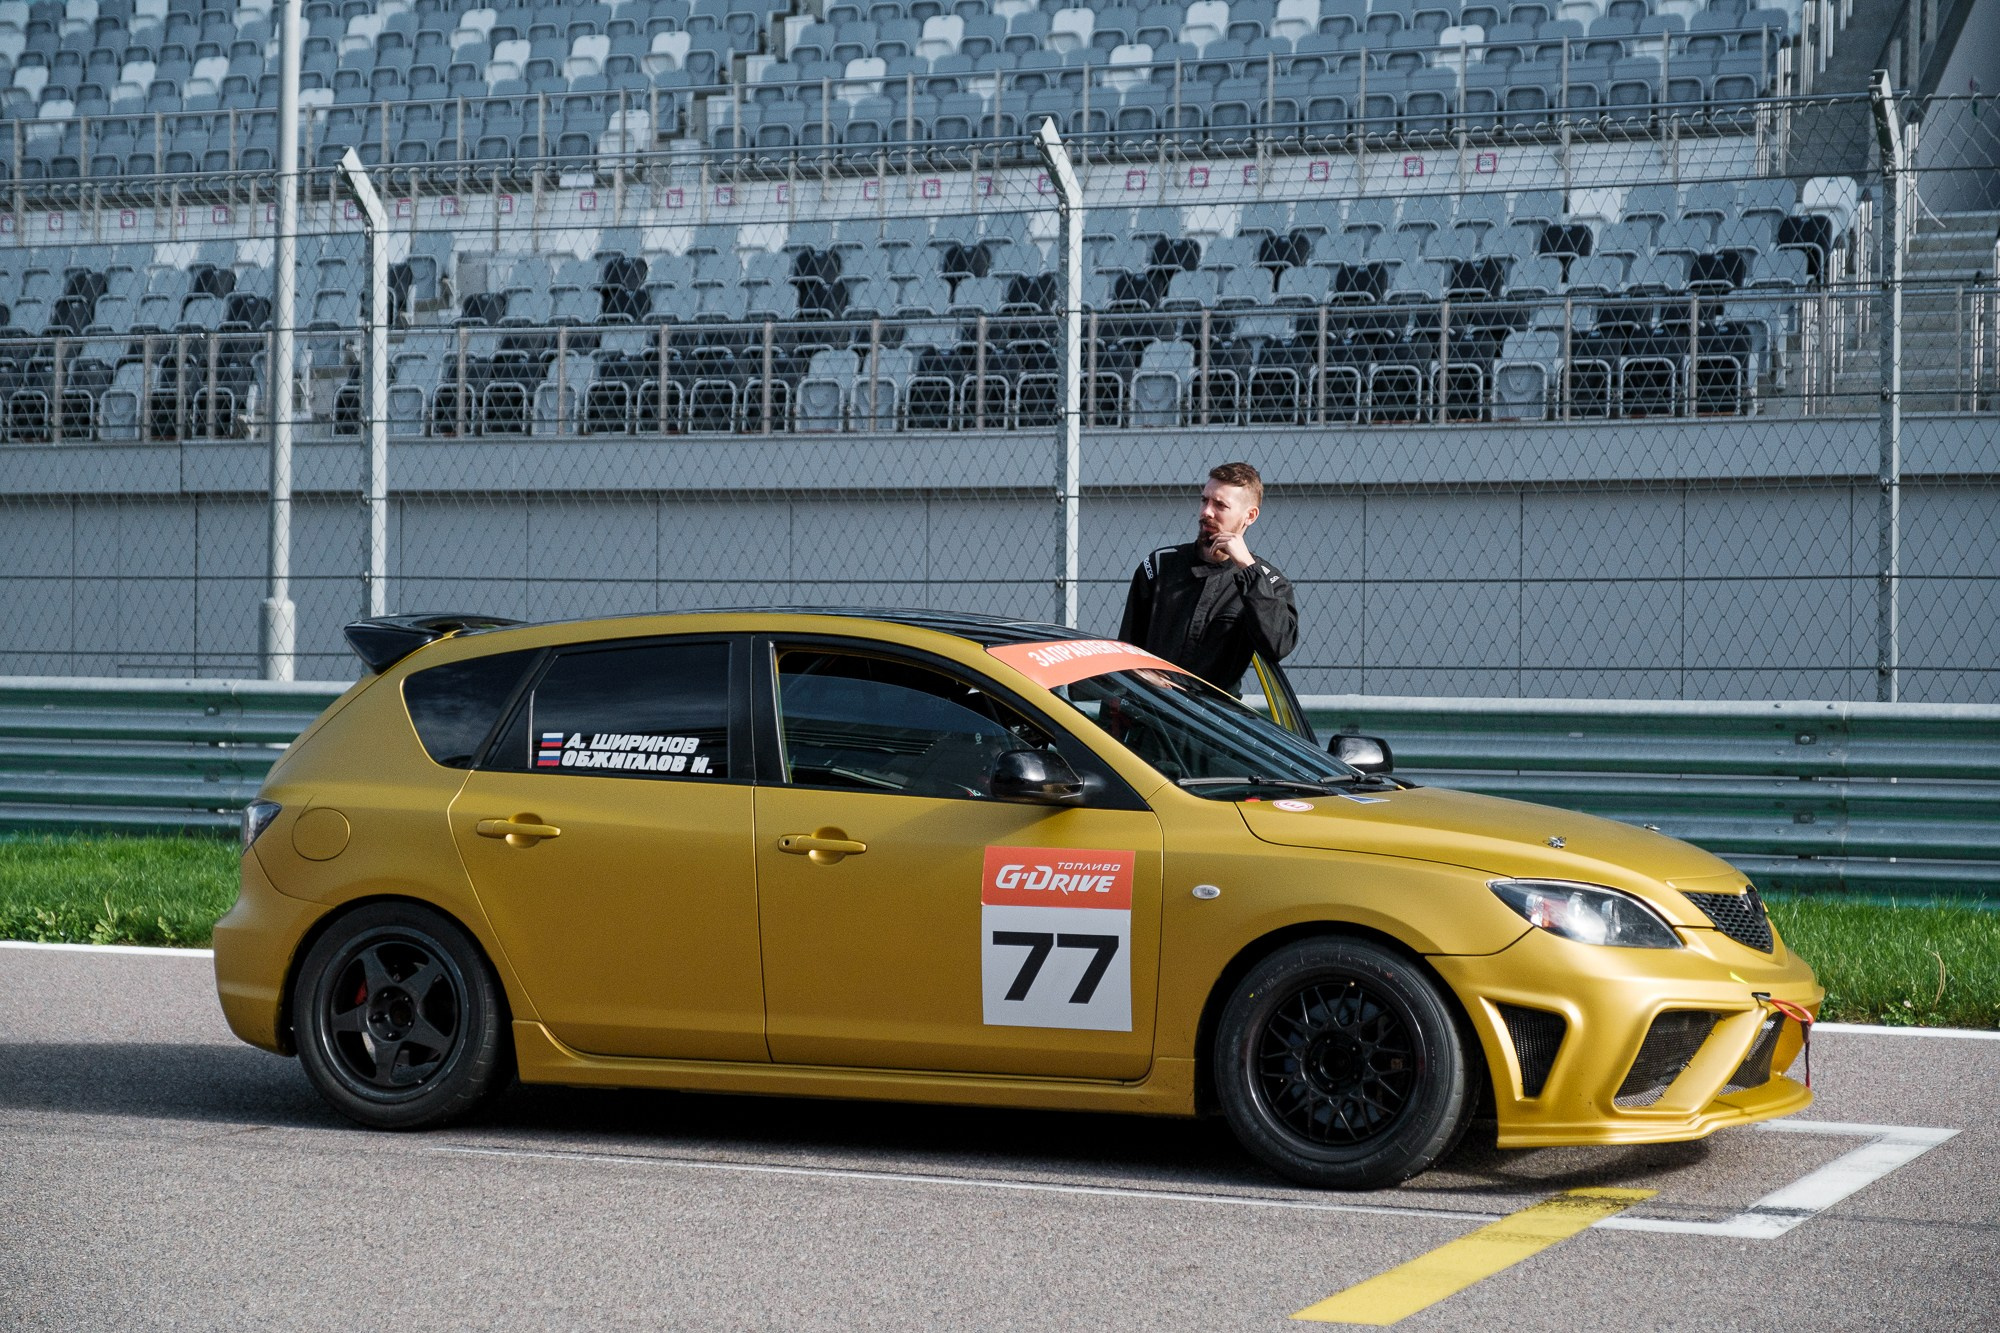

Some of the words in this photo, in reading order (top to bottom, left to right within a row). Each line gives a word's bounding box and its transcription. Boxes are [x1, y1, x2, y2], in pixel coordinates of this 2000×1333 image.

[564, 733, 586, 749] А.
[589, 734, 700, 754] ШИРИНОВ
[561, 751, 687, 772] ОБЖИГАЛОВ
[1057, 862, 1121, 872] ТОПЛИВО
[993, 931, 1119, 1004] 77
